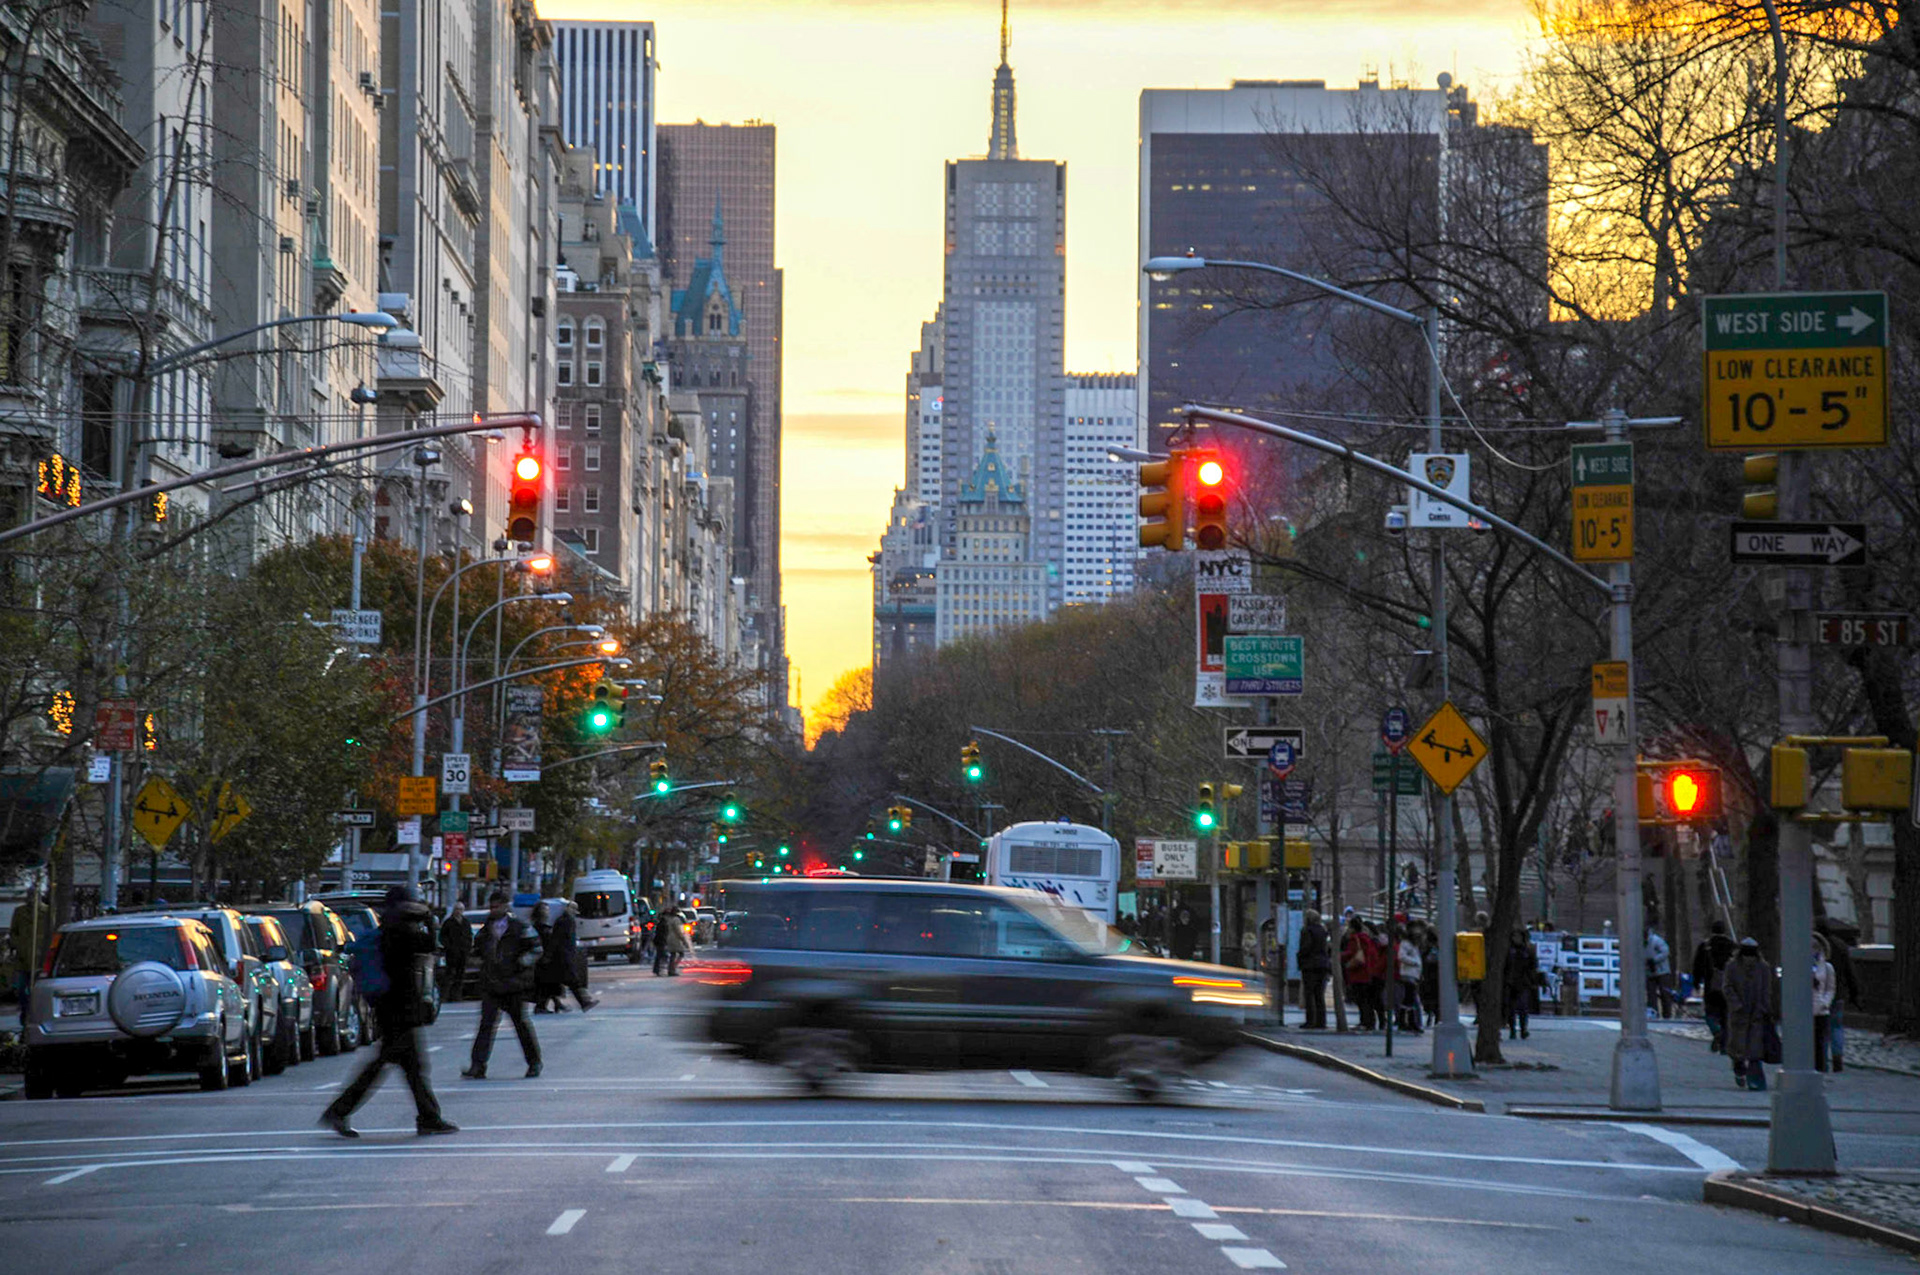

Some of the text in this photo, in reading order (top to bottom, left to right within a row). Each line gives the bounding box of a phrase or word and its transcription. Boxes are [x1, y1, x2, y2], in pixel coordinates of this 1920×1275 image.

[1716, 310, 1827, 334] WEST SIDE
[1717, 355, 1875, 380] LOW CLEARANCE
[1590, 456, 1629, 473] WEST SIDE
[1749, 535, 1849, 552] ONE WAY
[1200, 560, 1243, 576] NYC
[1818, 620, 1900, 645] E 85 ST
[1230, 640, 1297, 651] BEST ROUTE
[1231, 653, 1298, 664] CROSSTOWN
[1252, 665, 1275, 676] USE
[1233, 738, 1255, 748] ONE
[446, 770, 467, 782] 30
[1161, 843, 1188, 851] BUSES
[1164, 853, 1185, 861] ONLY
[133, 991, 179, 1001] HONDA
